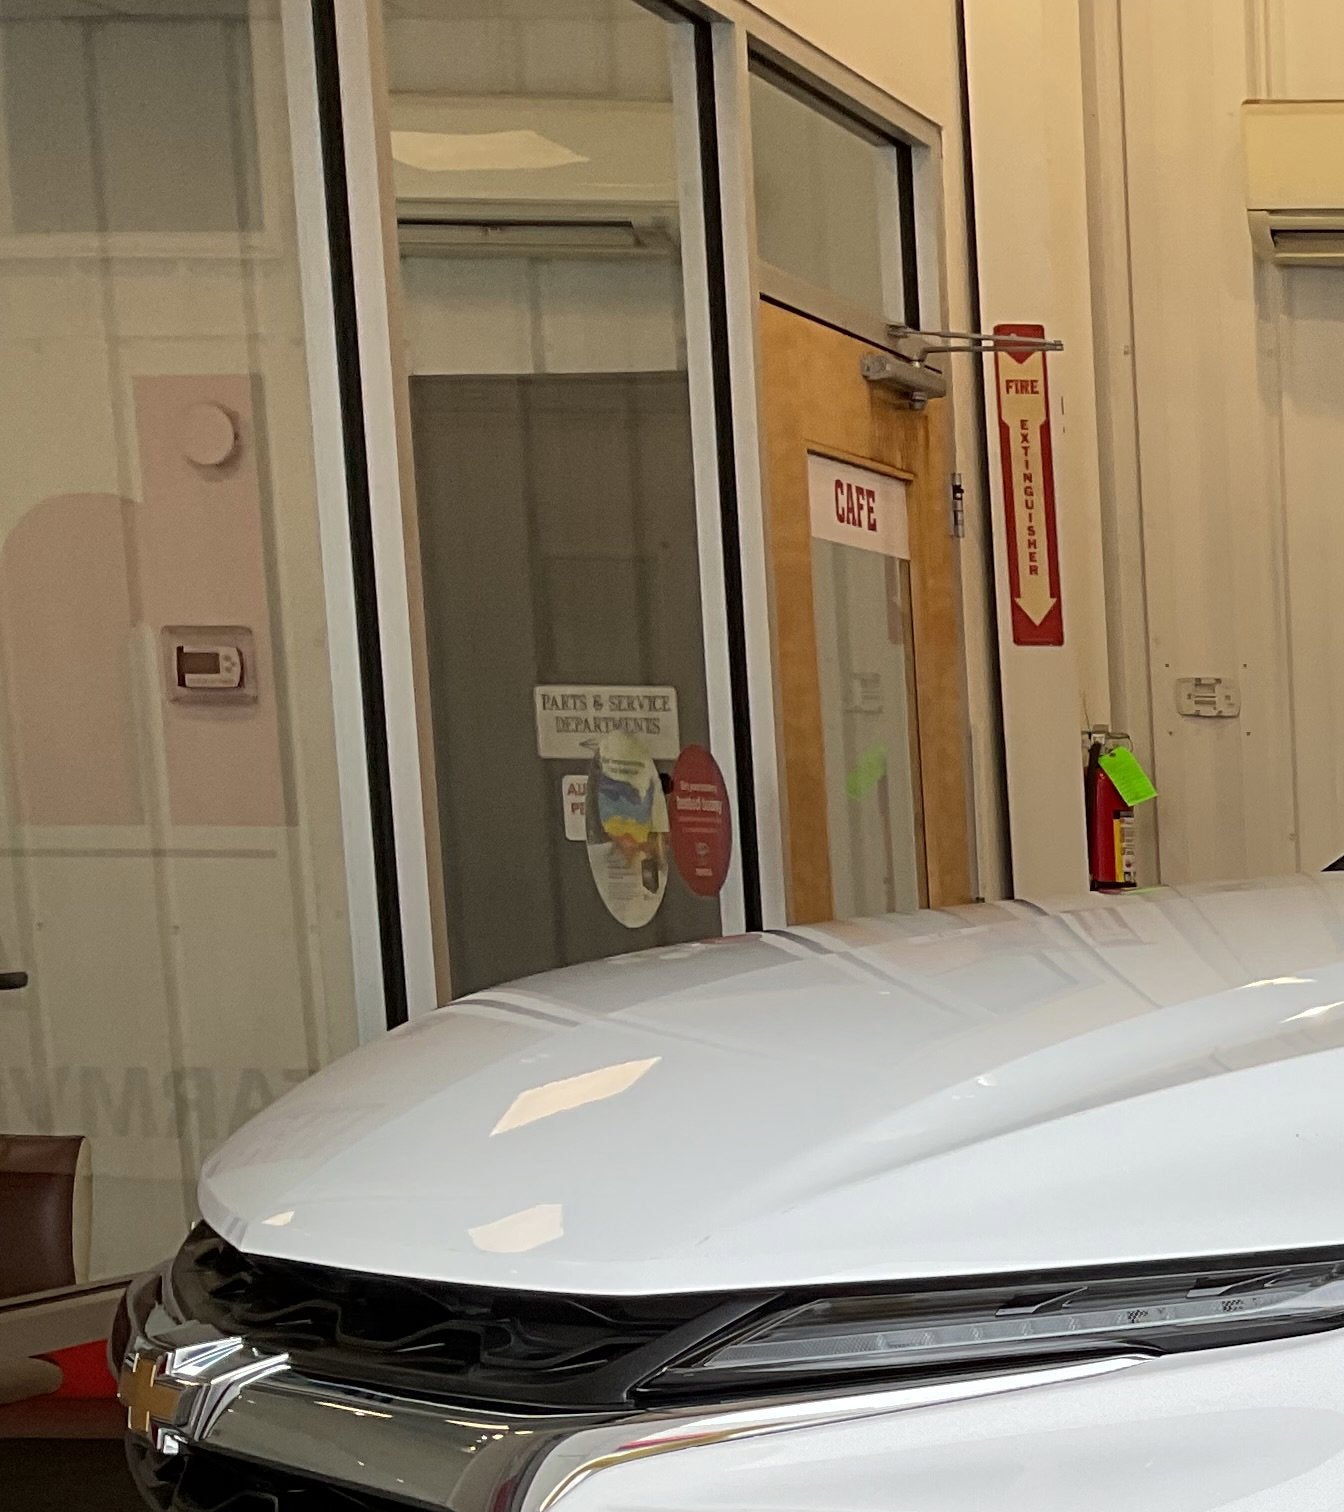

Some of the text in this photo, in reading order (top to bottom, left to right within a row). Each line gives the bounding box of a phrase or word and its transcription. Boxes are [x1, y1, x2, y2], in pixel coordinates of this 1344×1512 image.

[1005, 379, 1040, 395] FIRE
[834, 479, 877, 532] CAFE
[1019, 419, 1039, 576] EXTINGUISHER
[541, 694, 672, 712] PARTS & SERVICE
[555, 716, 661, 734] DEPARTMENTS
